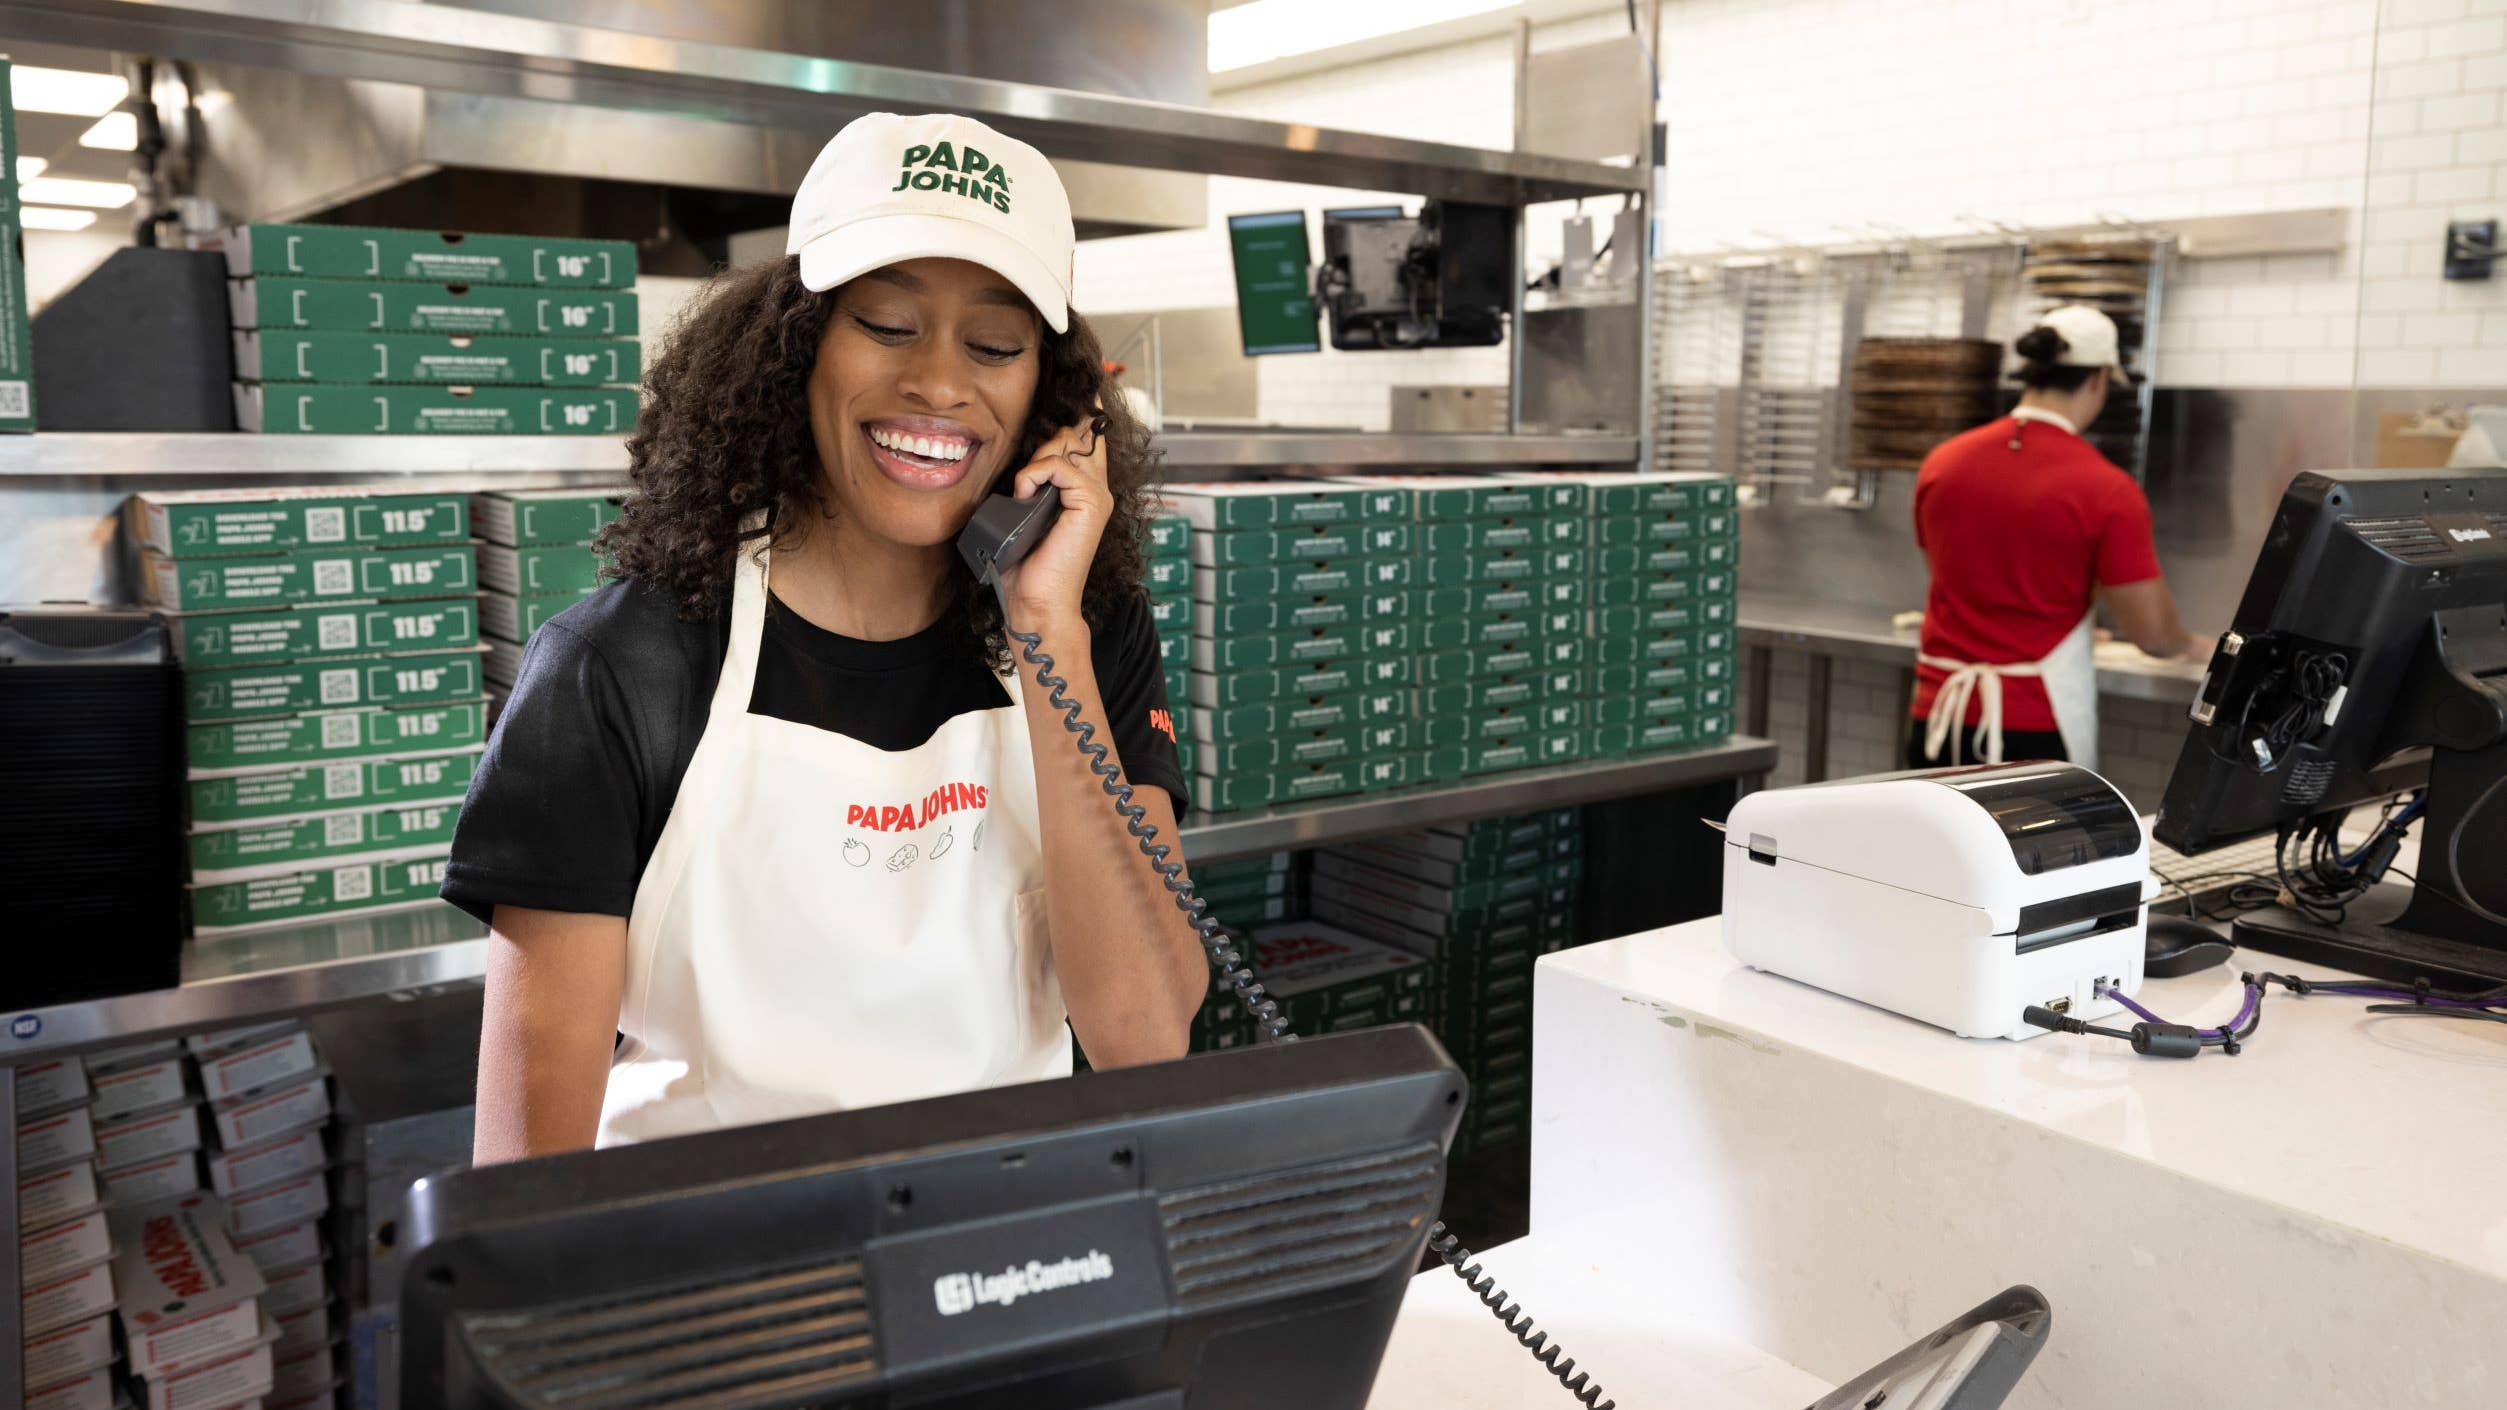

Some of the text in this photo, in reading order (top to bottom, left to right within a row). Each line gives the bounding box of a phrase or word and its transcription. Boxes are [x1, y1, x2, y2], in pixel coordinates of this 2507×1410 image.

[892, 170, 1011, 214] JOHNS
[902, 141, 1010, 194] PAPA
[847, 782, 987, 832] PAPA JOHNS
